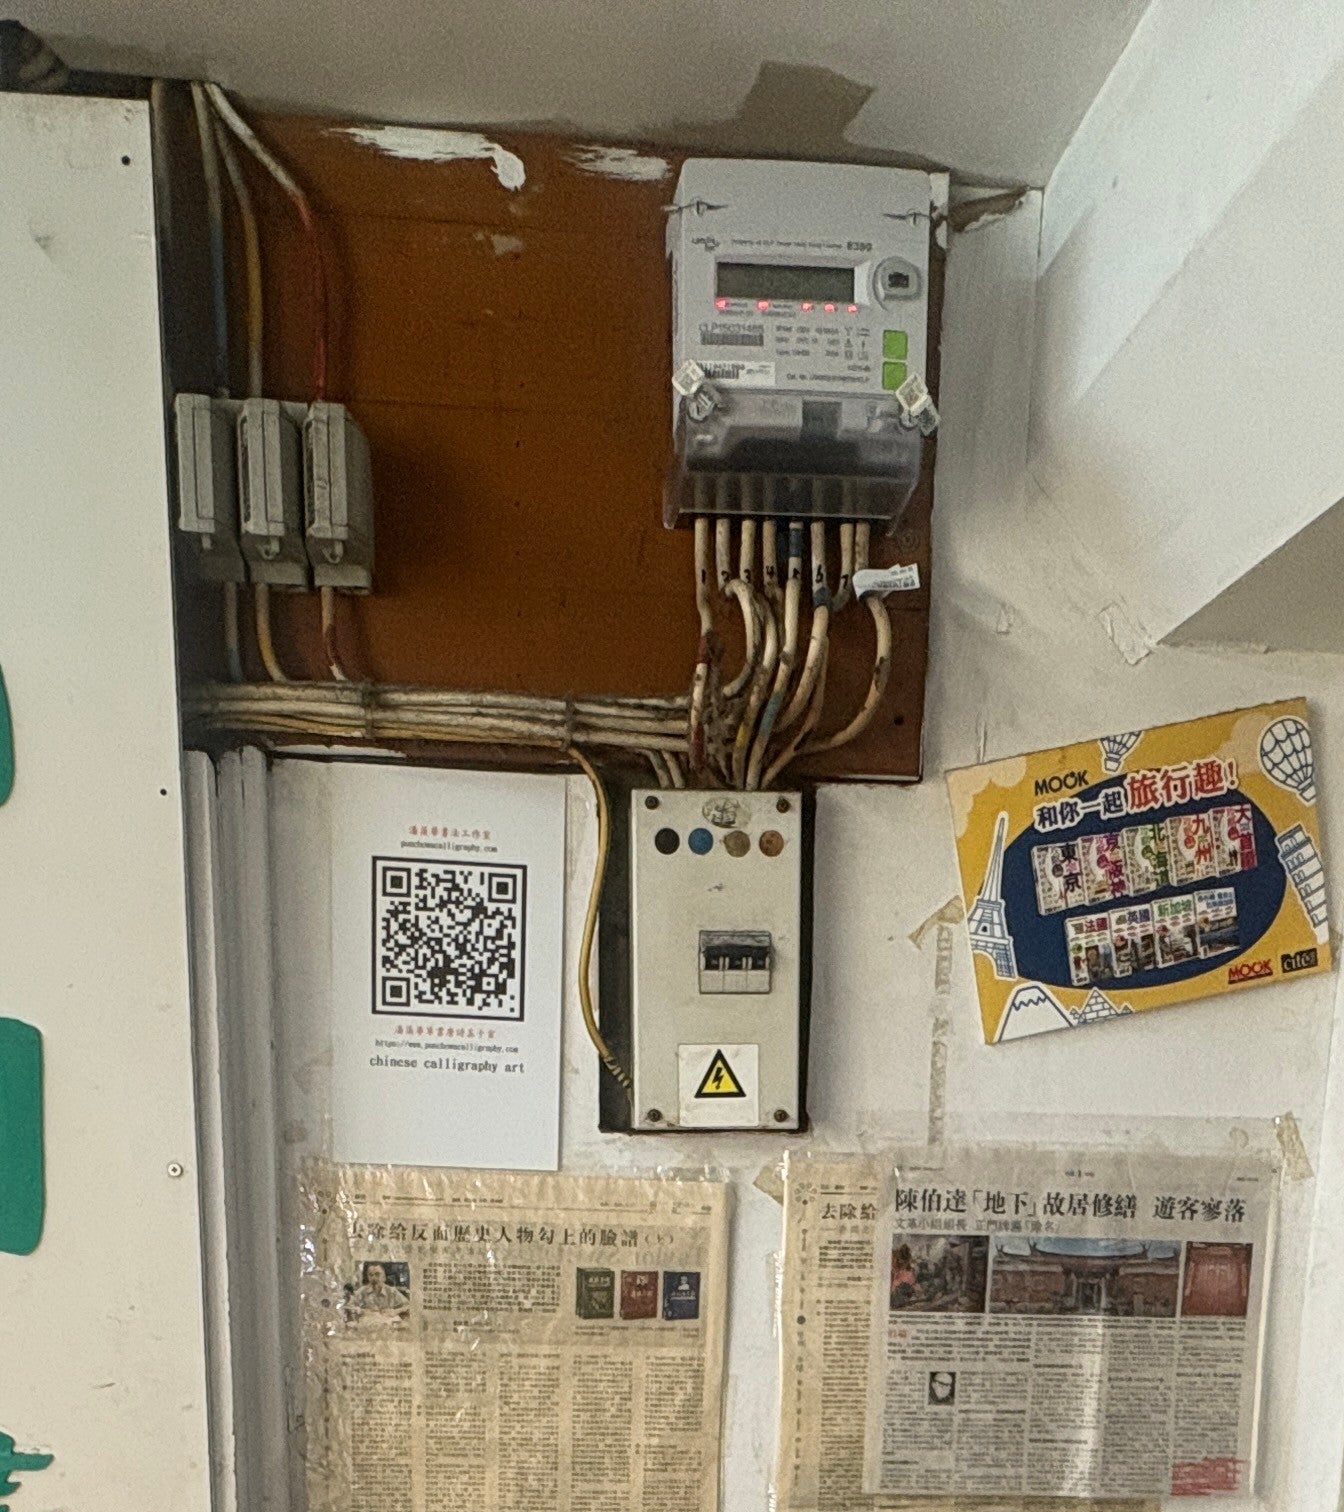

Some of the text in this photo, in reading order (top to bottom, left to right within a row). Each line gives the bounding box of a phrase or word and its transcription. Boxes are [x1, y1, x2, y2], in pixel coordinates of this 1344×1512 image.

[1034, 770, 1090, 796] MOOK
[1060, 843, 1083, 893] 東京
[1228, 958, 1273, 979] MOOK
[369, 1055, 525, 1073] chinese calligraphy art
